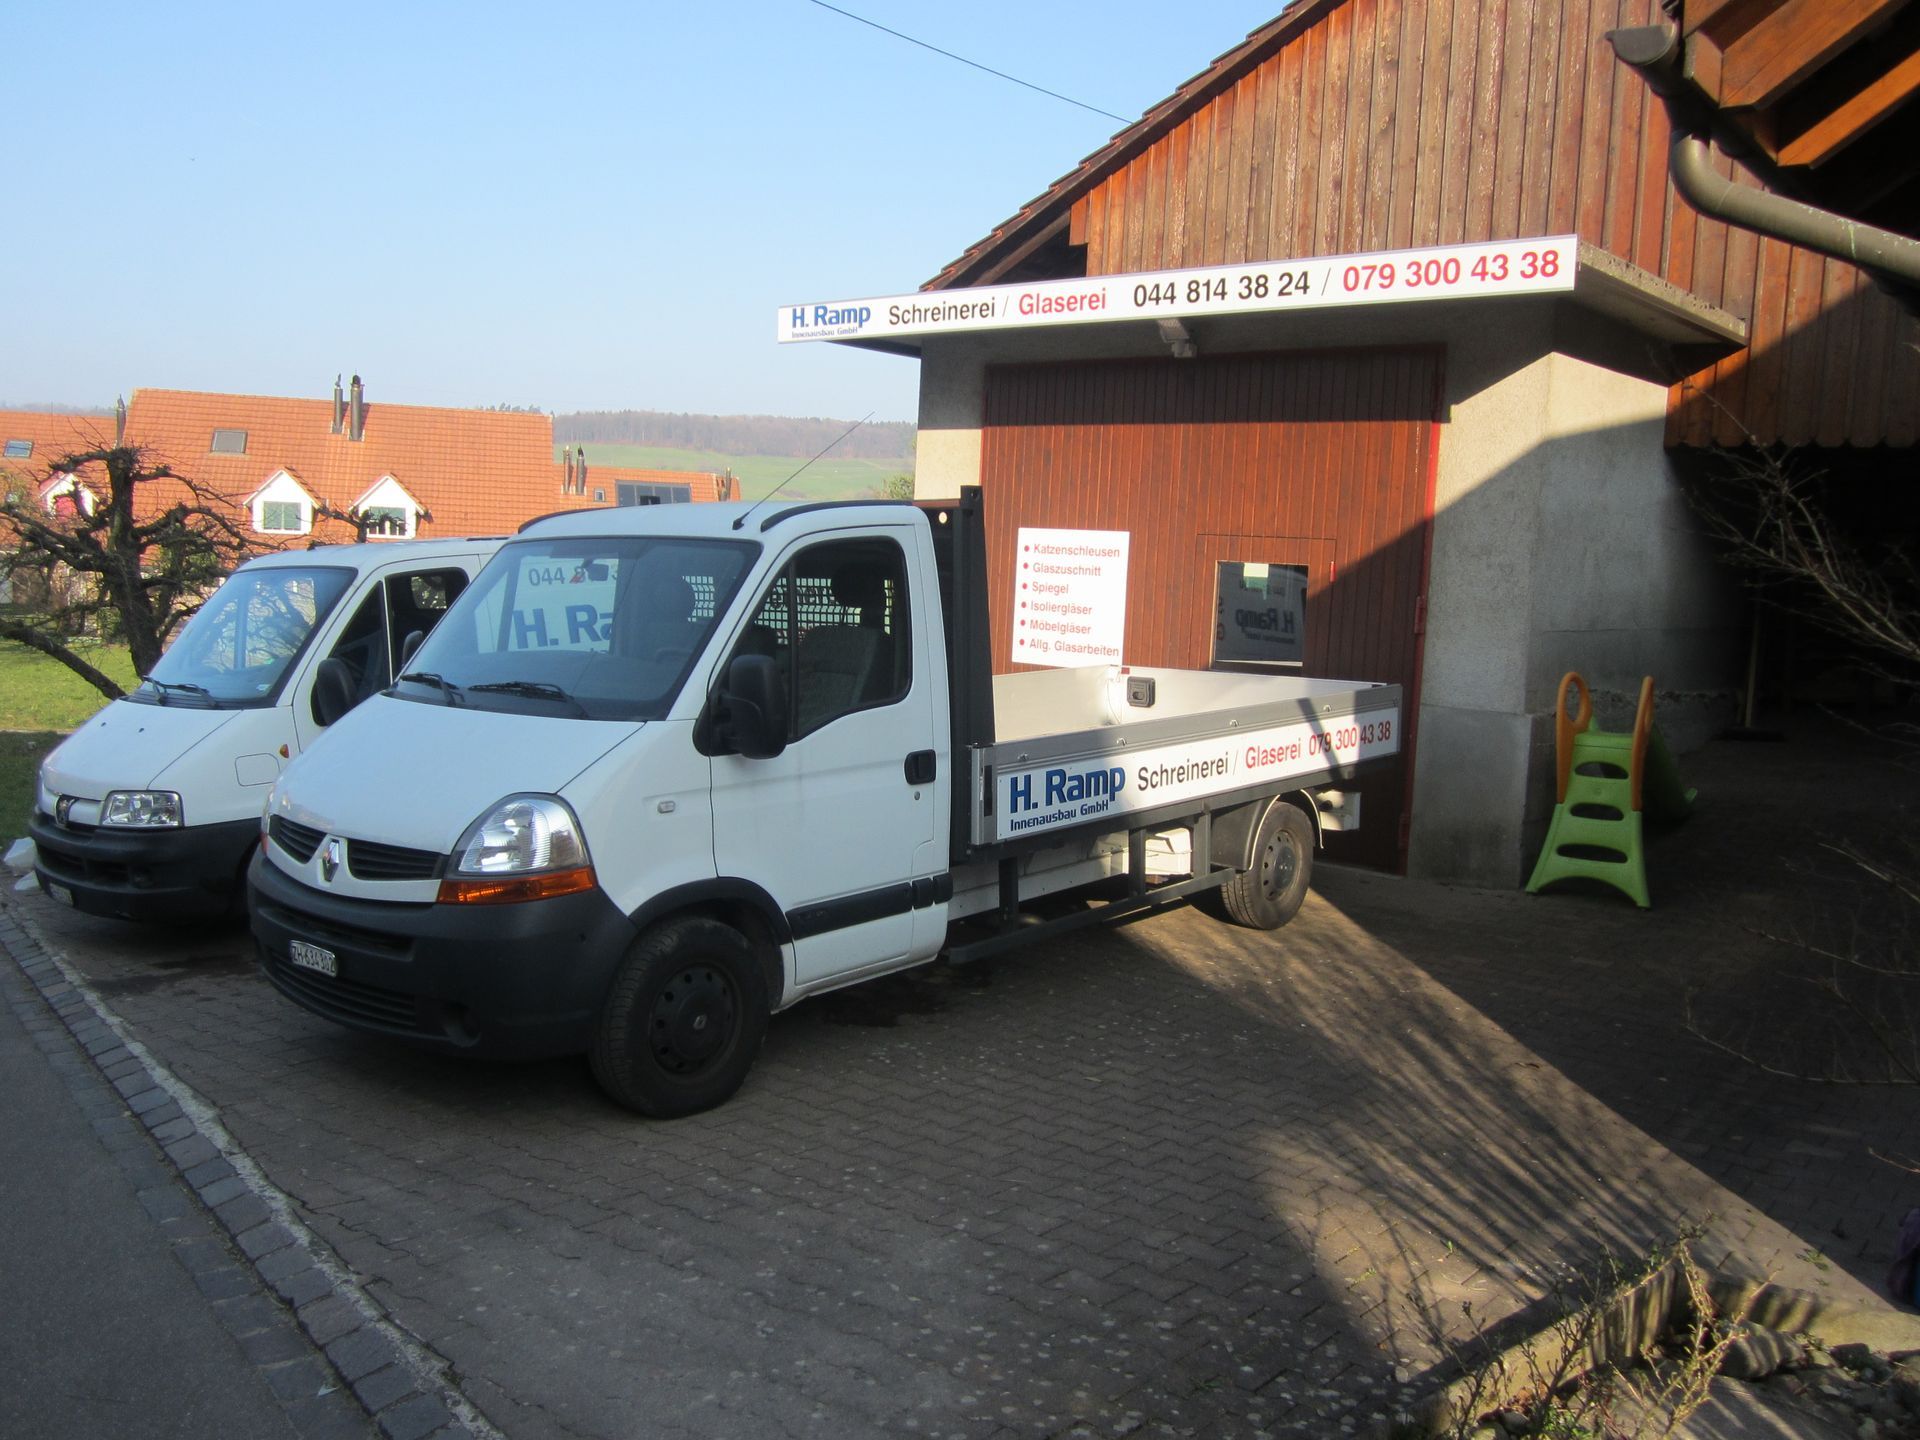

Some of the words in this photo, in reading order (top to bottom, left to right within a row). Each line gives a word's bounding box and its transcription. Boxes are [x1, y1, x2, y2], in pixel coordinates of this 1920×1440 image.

[889, 297, 995, 325] Schreinerei
[1018, 287, 1106, 315] Glaserei
[1134, 282, 1176, 307] 044
[1186, 278, 1228, 303] 814
[1238, 274, 1269, 299] 38
[1278, 271, 1310, 296] 24
[1343, 263, 1395, 291] 079
[1405, 258, 1460, 287] 300
[1471, 254, 1509, 281] 43
[1520, 250, 1559, 278] 38
[792, 308, 809, 328] H.
[814, 305, 871, 328] Ramp
[792, 330, 834, 338] Innenausbau
[837, 327, 858, 335] GmbH
[1033, 544, 1120, 557] Katzenschleusen
[529, 567, 565, 587] 044
[1033, 562, 1101, 576] Glaszuschnitt
[1032, 582, 1069, 596] Spiegel
[1031, 600, 1092, 615] Isoliergläser
[512, 608, 559, 649] H.
[1030, 619, 1091, 634] Möbelgläser
[1030, 639, 1051, 652] Allg.
[1054, 640, 1119, 656] Glasarbeiten
[1010, 774, 1038, 814] H.
[1045, 767, 1125, 806] Ramp
[1138, 752, 1228, 791] Schreinerei
[1245, 738, 1301, 769] Glaserei
[1309, 732, 1331, 756] 079
[1335, 727, 1358, 750] 300
[1360, 724, 1374, 744] 43
[1377, 720, 1391, 741] 38
[1010, 809, 1076, 831] Innenausbau
[1080, 799, 1108, 816] GmbH
